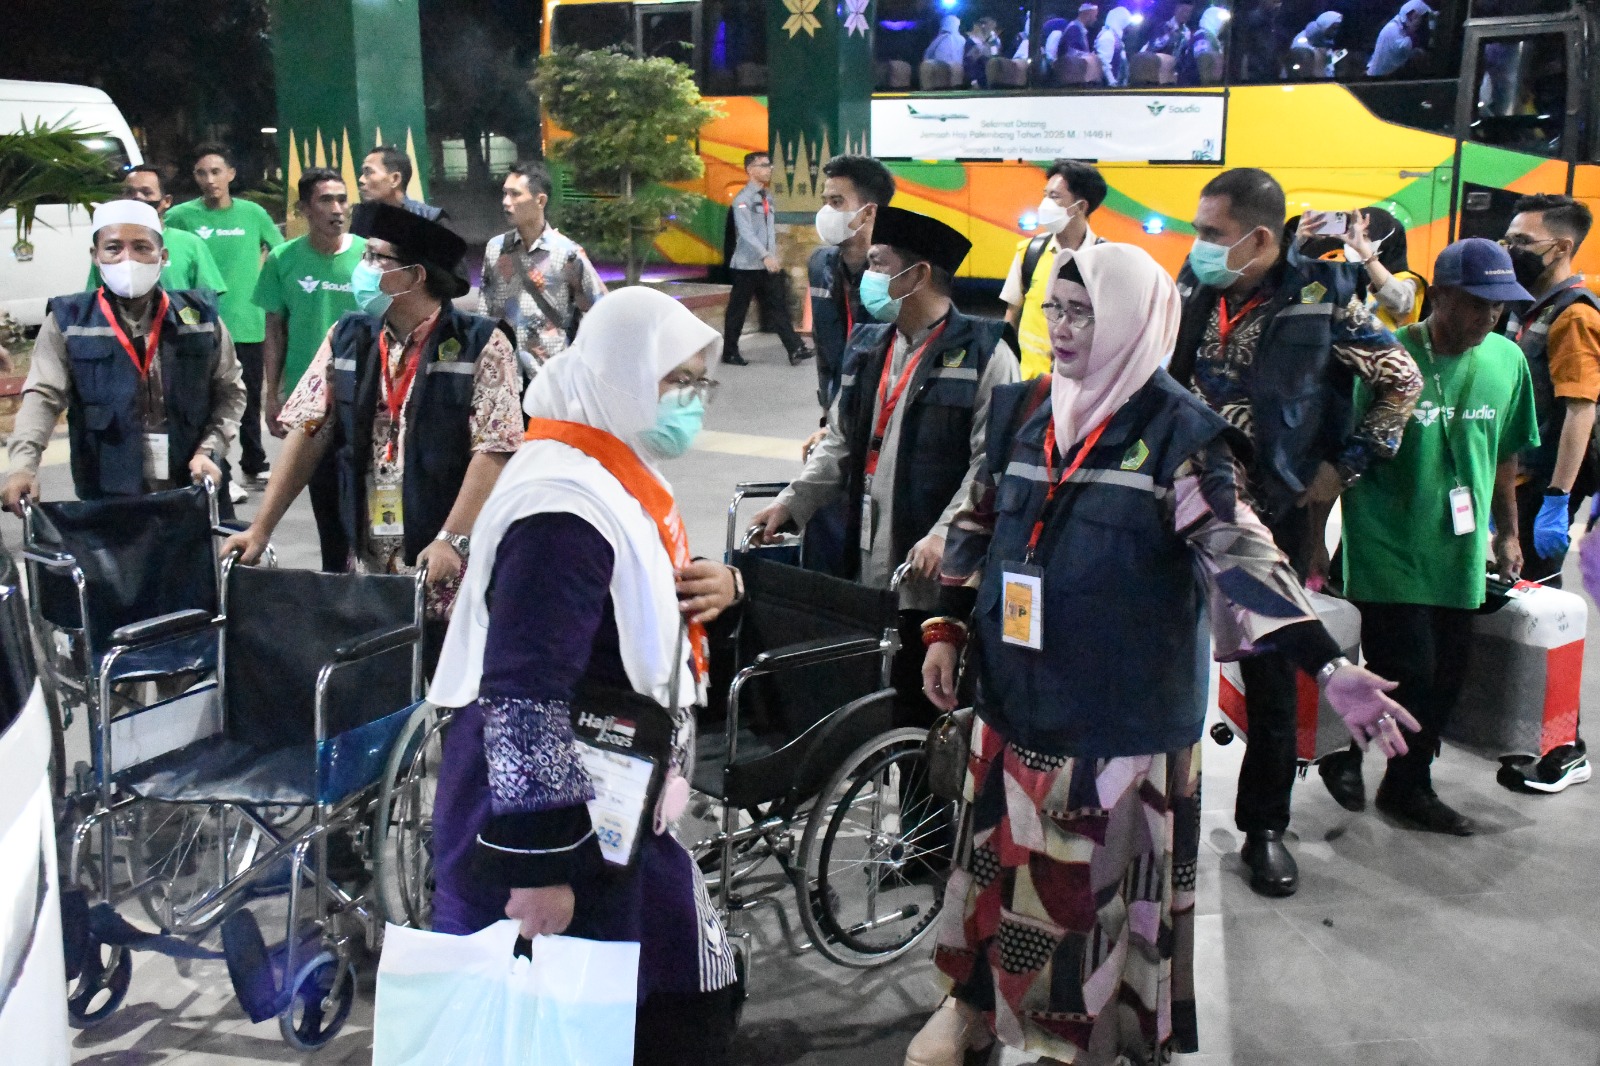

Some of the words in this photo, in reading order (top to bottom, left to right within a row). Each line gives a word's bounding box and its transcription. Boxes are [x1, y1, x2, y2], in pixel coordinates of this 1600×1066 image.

[1168, 104, 1201, 114] Saudia
[981, 120, 1014, 128] Selamat
[1016, 120, 1047, 129] Datang
[969, 130, 1015, 140] Palembang
[1017, 130, 1042, 139] Tahun
[1067, 130, 1076, 138] M
[1105, 130, 1113, 138] H
[215, 227, 246, 237] Saudia
[1446, 404, 1496, 419] Sudia
[578, 711, 616, 740] Haji
